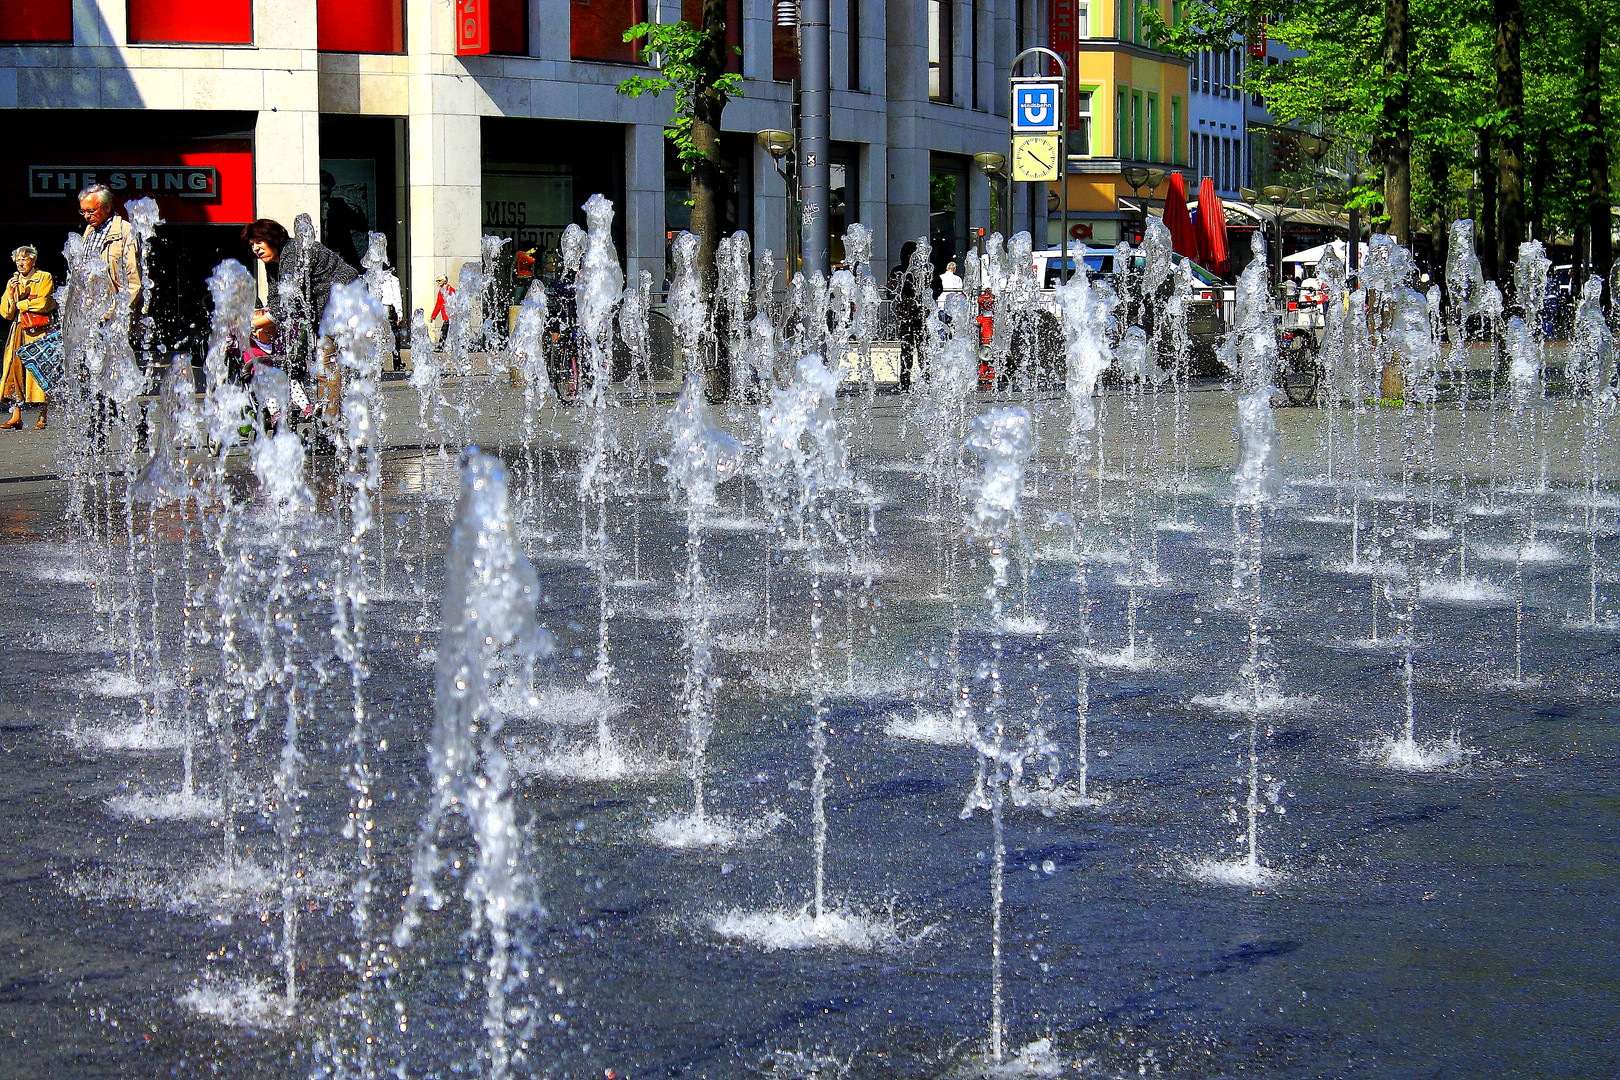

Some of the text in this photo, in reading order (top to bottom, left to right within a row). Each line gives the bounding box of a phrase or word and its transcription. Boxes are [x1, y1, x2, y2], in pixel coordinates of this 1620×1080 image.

[1025, 94, 1047, 123] U
[37, 172, 207, 190] THE STING
[486, 201, 526, 225] MISS
